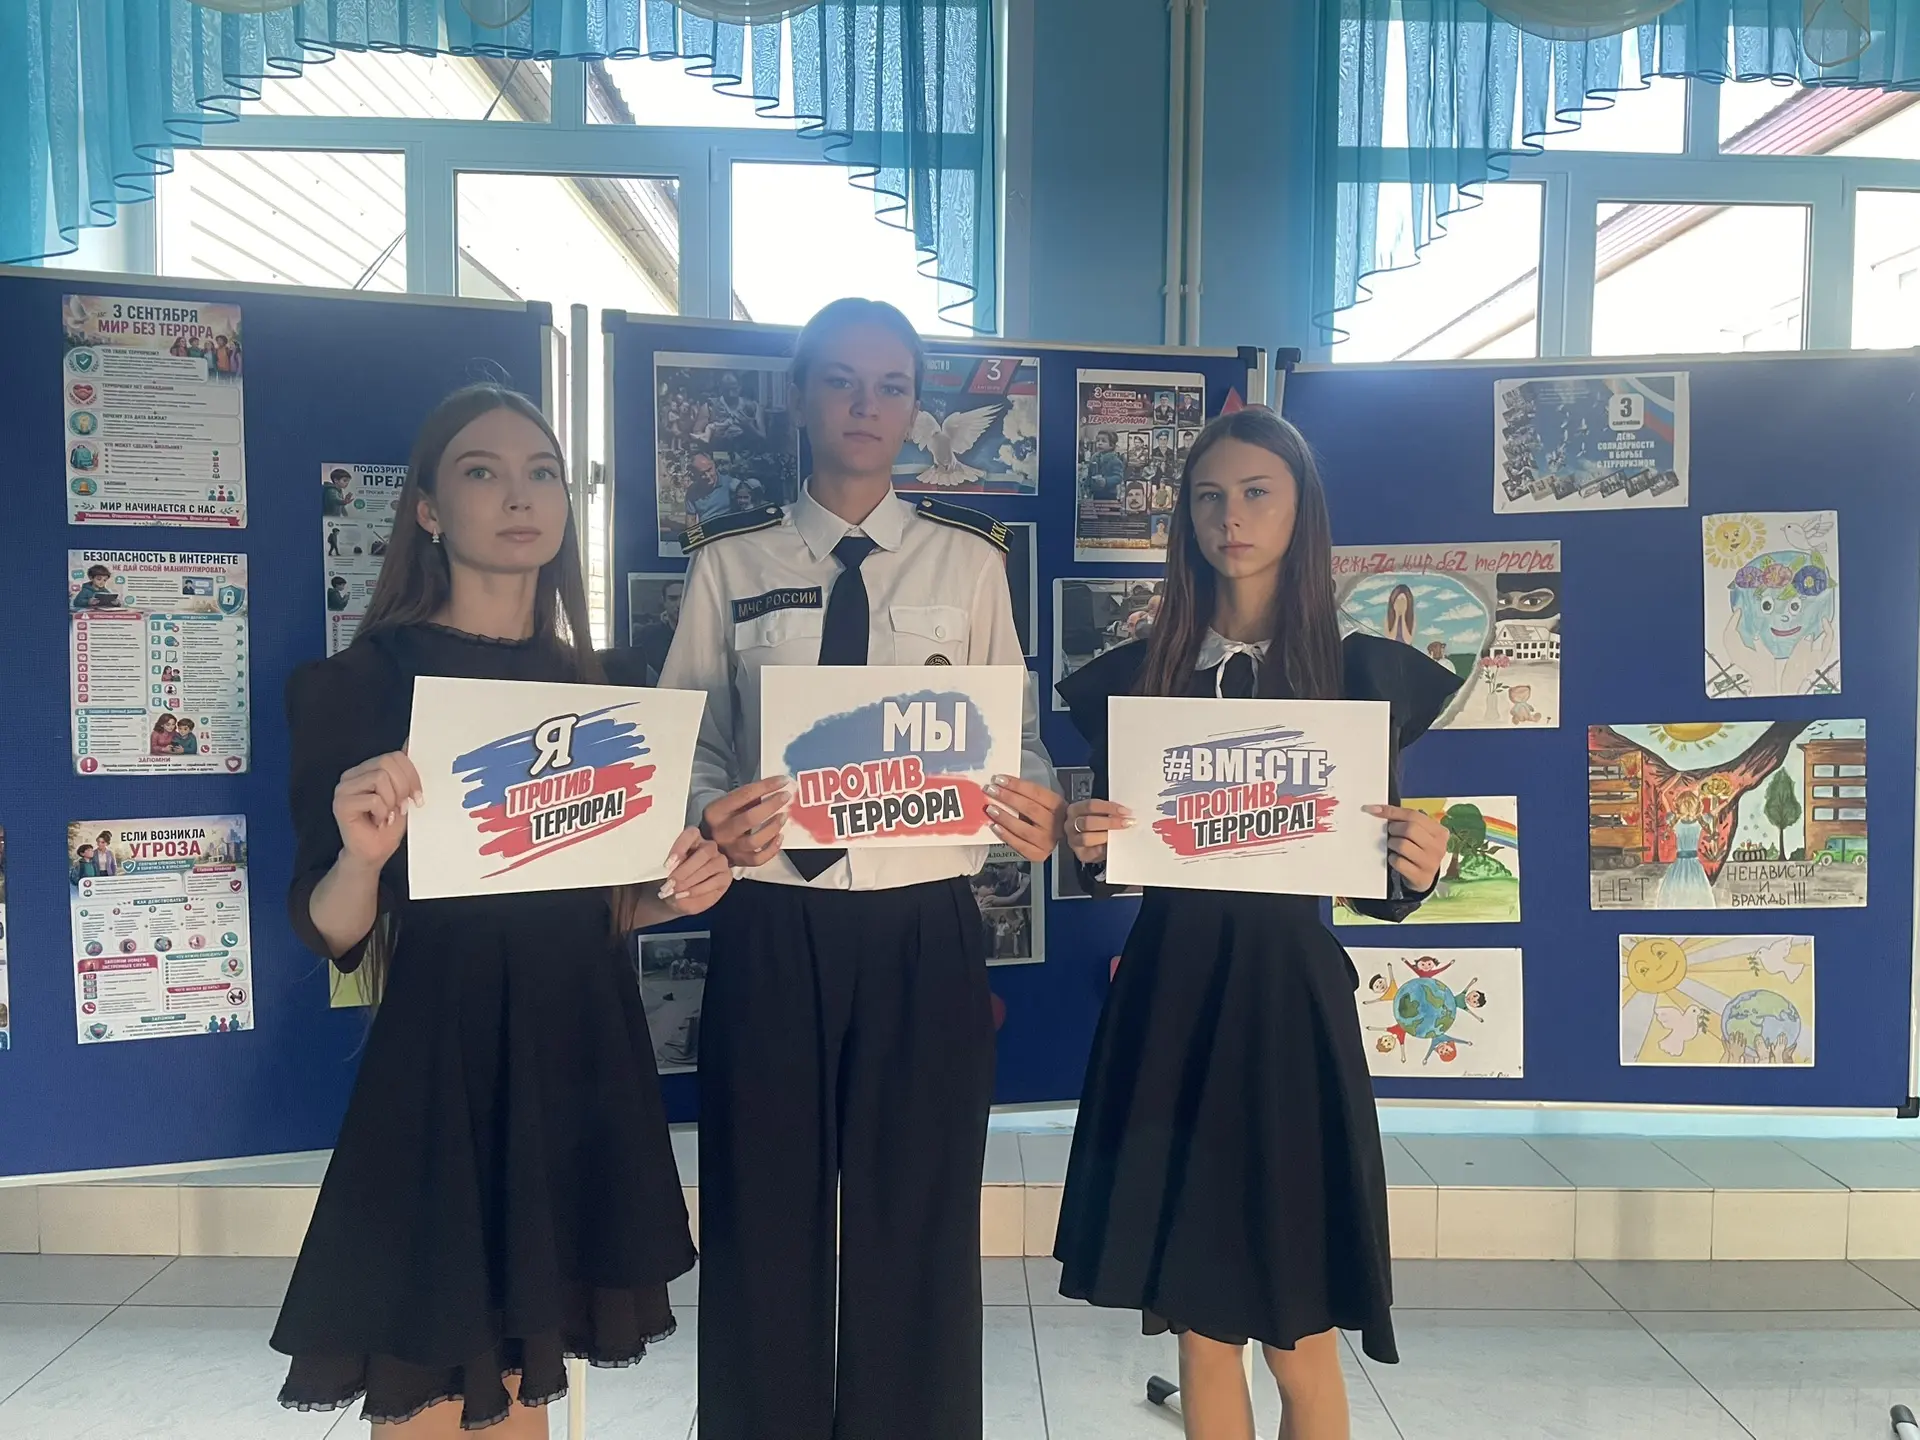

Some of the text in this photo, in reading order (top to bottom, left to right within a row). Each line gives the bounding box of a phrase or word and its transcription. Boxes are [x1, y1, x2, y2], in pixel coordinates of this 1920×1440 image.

[113, 304, 198, 323] 3 СЕНТЯБРЯ
[98, 319, 213, 339] МИР БЕЗ ТЕРРОРА
[987, 359, 1002, 380] 3
[1620, 397, 1632, 418] 3
[1597, 441, 1655, 450] СОЛИДАРНОСТИ
[1616, 432, 1636, 441] ДЕНЬ
[1603, 459, 1656, 468] ТЕРРОРИЗМОМ
[1616, 450, 1643, 459] БОРЬБЕ
[363, 475, 405, 489] ПРЕД
[100, 501, 216, 514] МИР НАЧИНАЕТСЯ С НАС
[83, 551, 238, 565] БЕЗОПАСНОСТЬ В ИНТЕРНЕТЕ
[122, 564, 137, 572] ДАЙ
[139, 564, 162, 573] СОБОЙ
[163, 565, 226, 574] МАНИПУЛИРОВАТЬ
[738, 591, 817, 617] МЧС РОССИИ
[883, 701, 967, 752] МЫ
[529, 714, 579, 776] Я
[1164, 747, 1328, 787] #ВМЕСТЕ
[508, 768, 592, 815] ПРОТИВ
[799, 757, 922, 806] ПРОТИВ
[1177, 781, 1278, 822] ПРОТИВ
[533, 791, 624, 840] ТЕРРОРА!
[830, 788, 961, 837] ТЕРРОРА
[1194, 801, 1314, 848] ТЕРРОРА!
[121, 829, 206, 842] ЕСЛИ ВОЗНИКЛА
[130, 840, 201, 859] УГРОЗА
[1726, 864, 1815, 880] НЕНАВИСТИ
[1598, 877, 1650, 902] НЕТ
[1731, 882, 1806, 906] ВРАЖДЫ!!!
[1760, 881, 1769, 892] И
